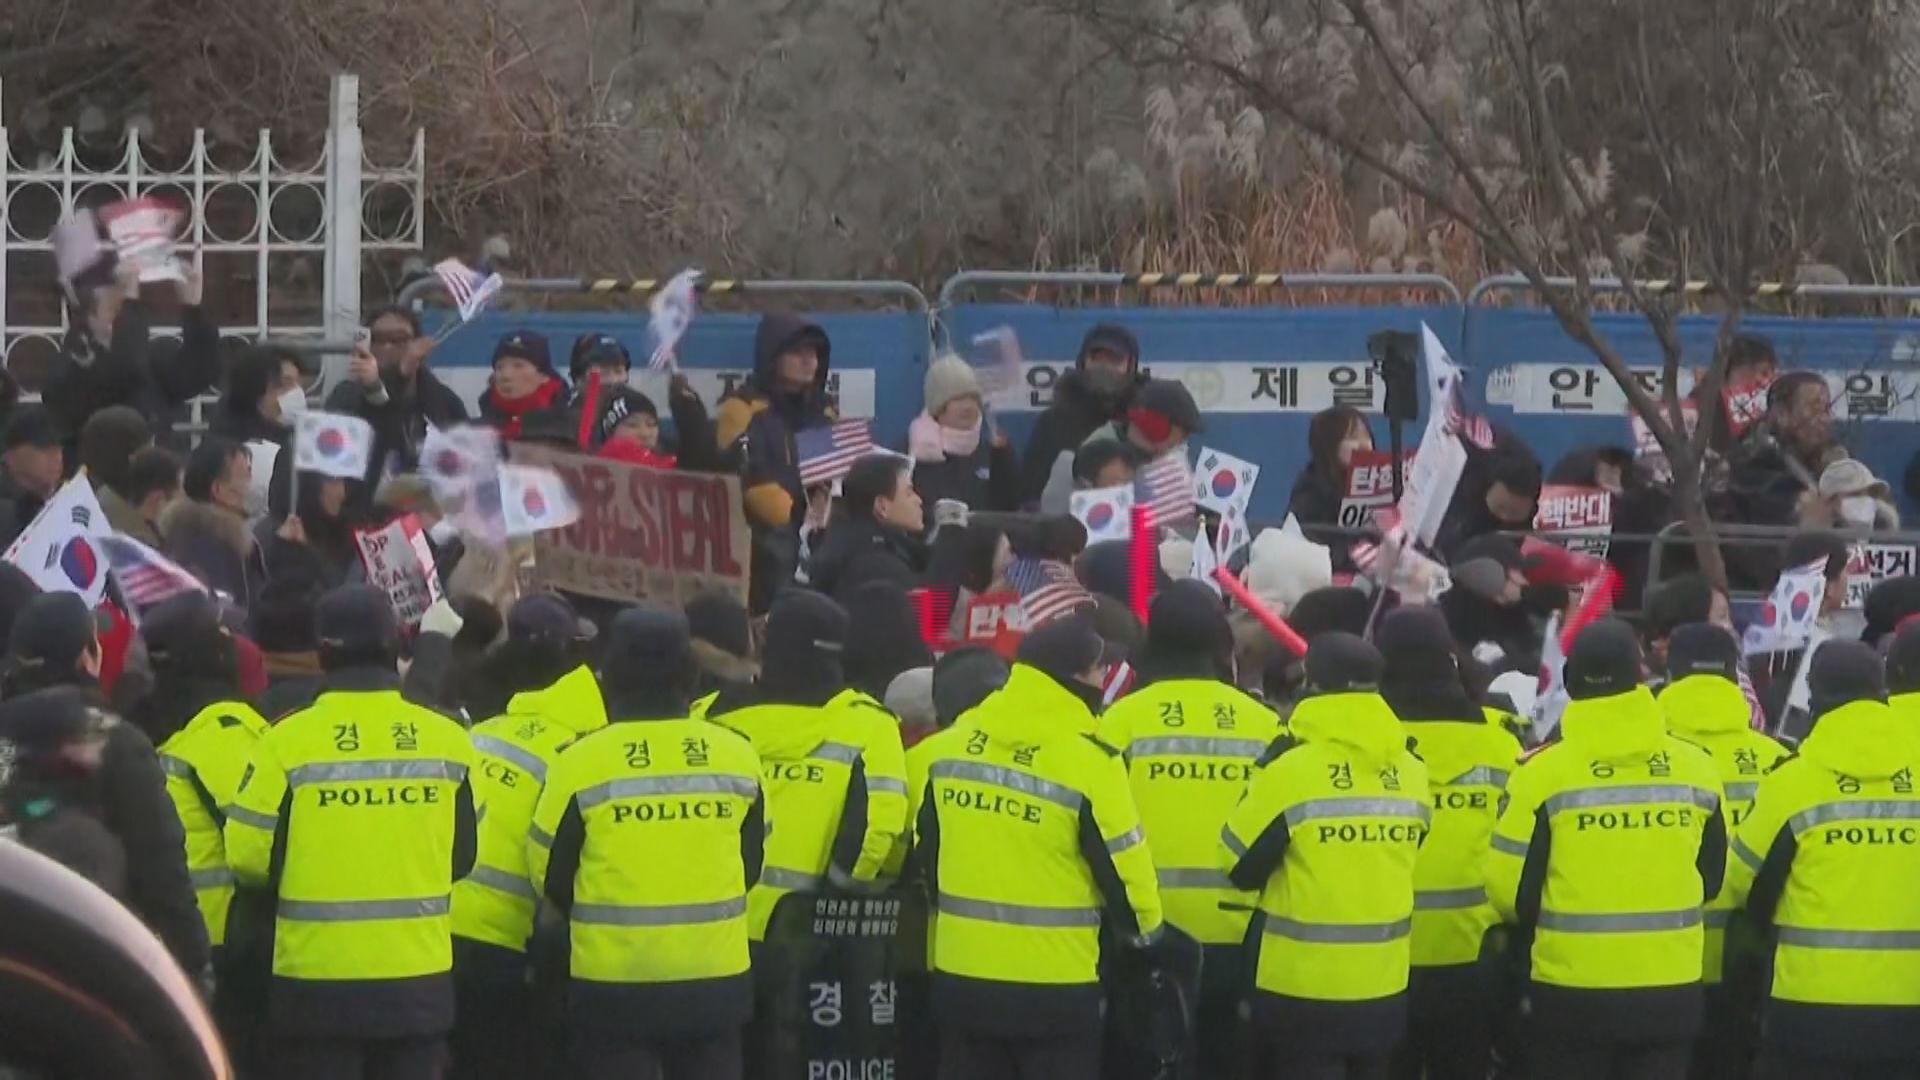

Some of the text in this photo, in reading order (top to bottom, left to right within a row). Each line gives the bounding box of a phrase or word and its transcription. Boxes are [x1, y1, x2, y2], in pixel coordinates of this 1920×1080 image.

[1846, 373, 1889, 416] 일
[1541, 491, 1611, 528] 핵반대
[630, 465, 743, 580] STEAL
[1866, 550, 1910, 578] 선거
[1733, 748, 1758, 775] 찰
[772, 763, 824, 783] ICE
[318, 785, 440, 807] POLICE
[943, 788, 1042, 824] POLICE
[1434, 792, 1488, 809] ICE
[612, 801, 733, 823] POLICE
[1577, 808, 1692, 831] POLICE
[1319, 824, 1418, 844] POLICE
[1825, 827, 1917, 845] POLIC
[808, 1058, 895, 1080] POLICE
